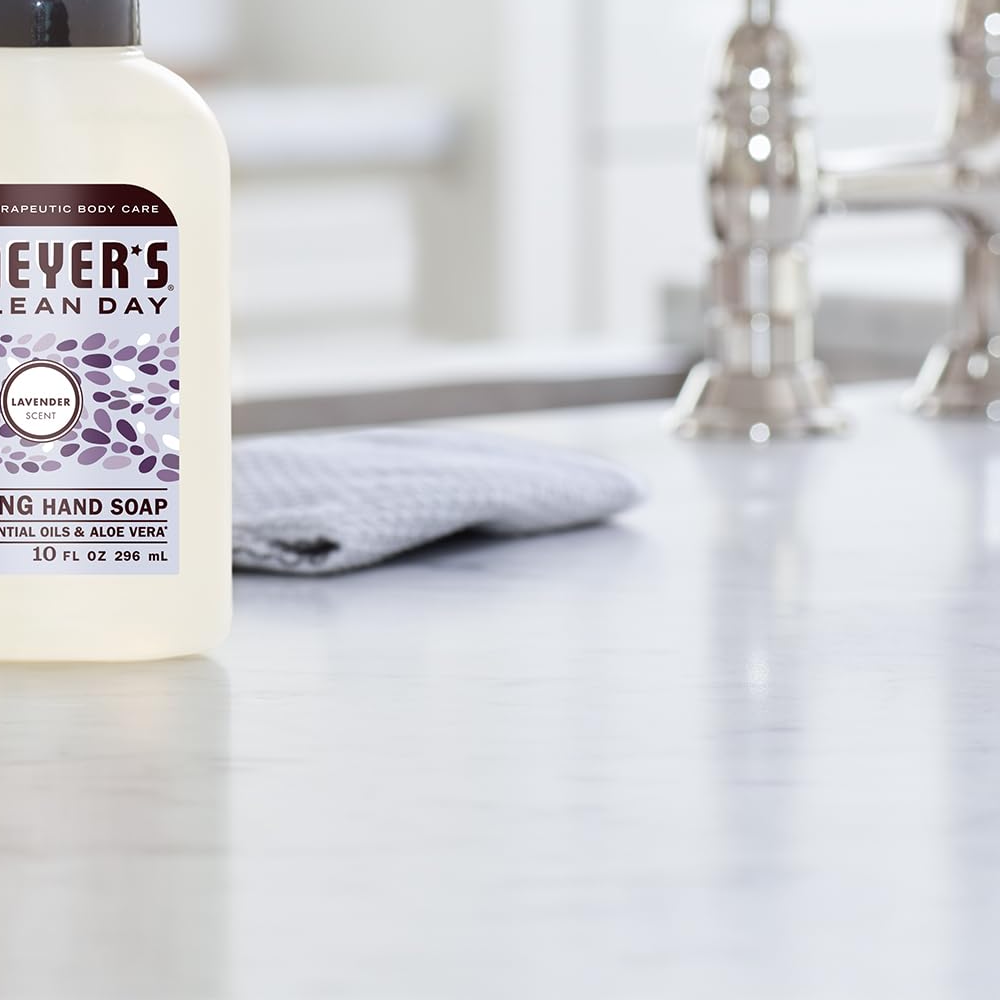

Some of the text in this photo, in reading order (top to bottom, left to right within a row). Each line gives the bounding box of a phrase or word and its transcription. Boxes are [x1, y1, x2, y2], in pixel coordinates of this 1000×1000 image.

[78, 205, 116, 214] BODY
[122, 205, 159, 214] CARE
[99, 297, 168, 315] DAY
[11, 398, 71, 407] LAVENDER
[25, 412, 56, 420] SCENT
[42, 498, 103, 516] HAND
[110, 498, 168, 516] SOAP
[40, 526, 70, 538] OILS
[74, 526, 85, 538] &
[90, 526, 125, 538] ALOE
[32, 546, 168, 562] 10 FL OZ 296 mL
